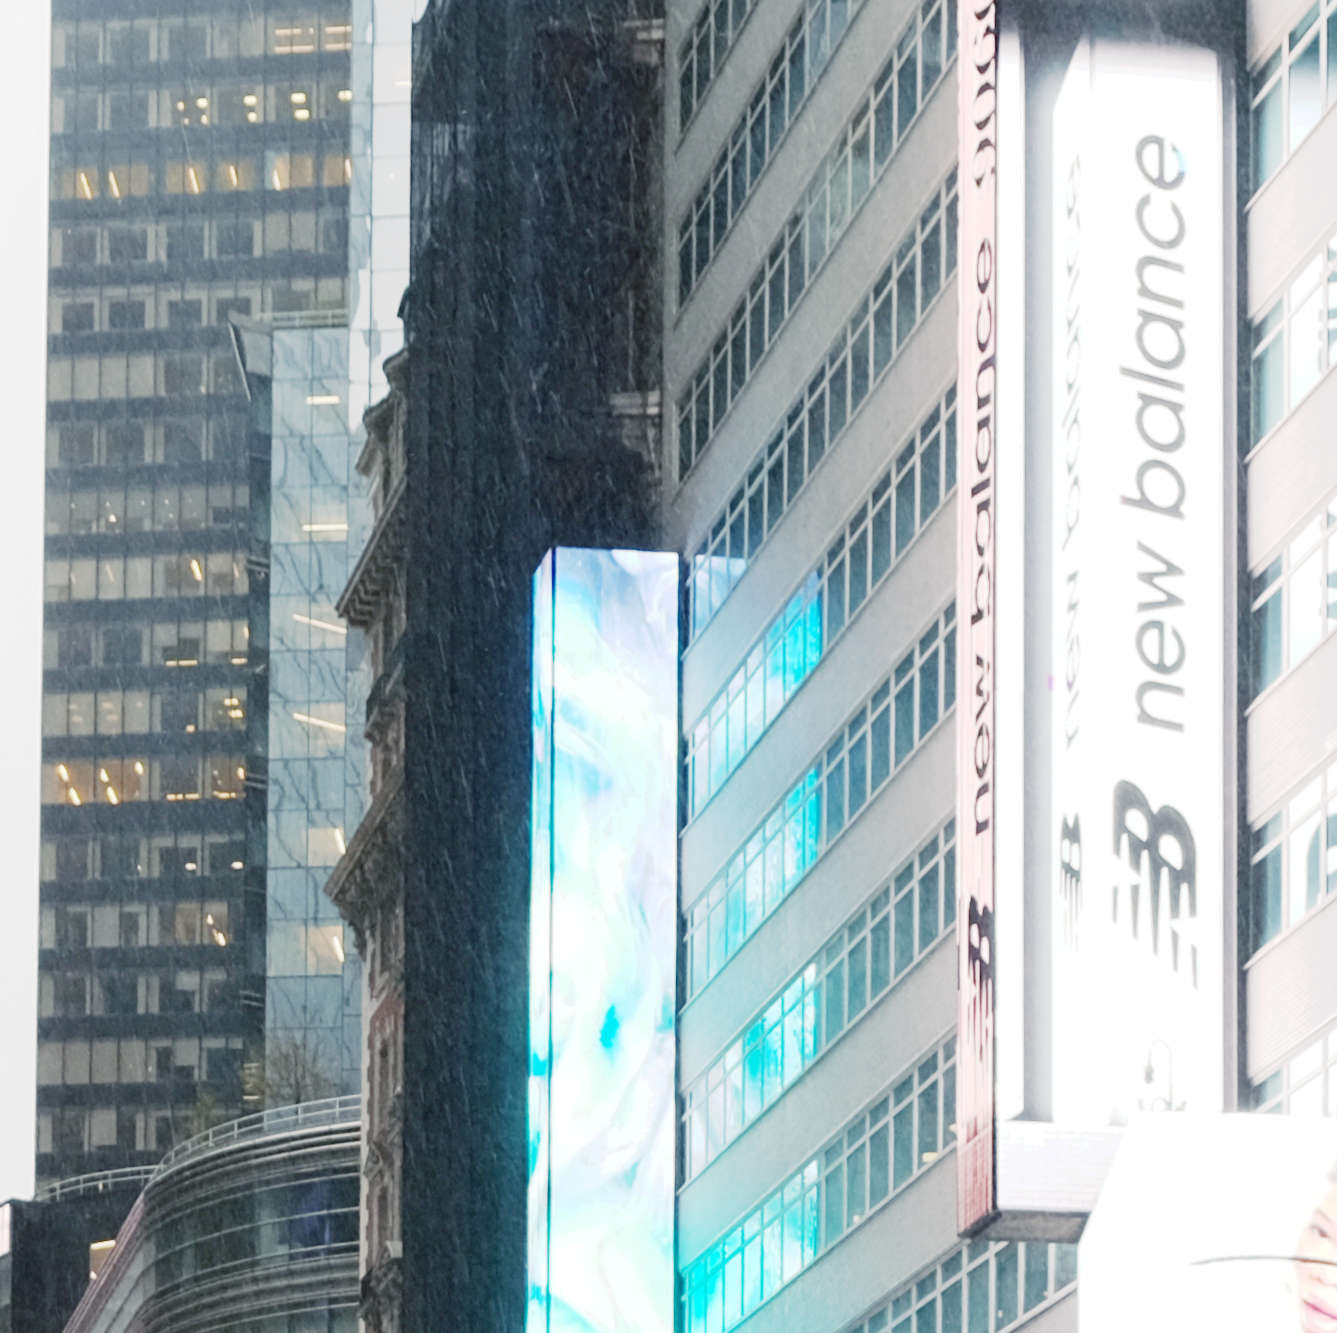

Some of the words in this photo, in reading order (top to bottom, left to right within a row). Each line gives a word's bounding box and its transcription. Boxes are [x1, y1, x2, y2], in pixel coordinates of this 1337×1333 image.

[970, 238, 995, 627] balance
[1121, 133, 1188, 521] balance
[1136, 543, 1186, 731] new
